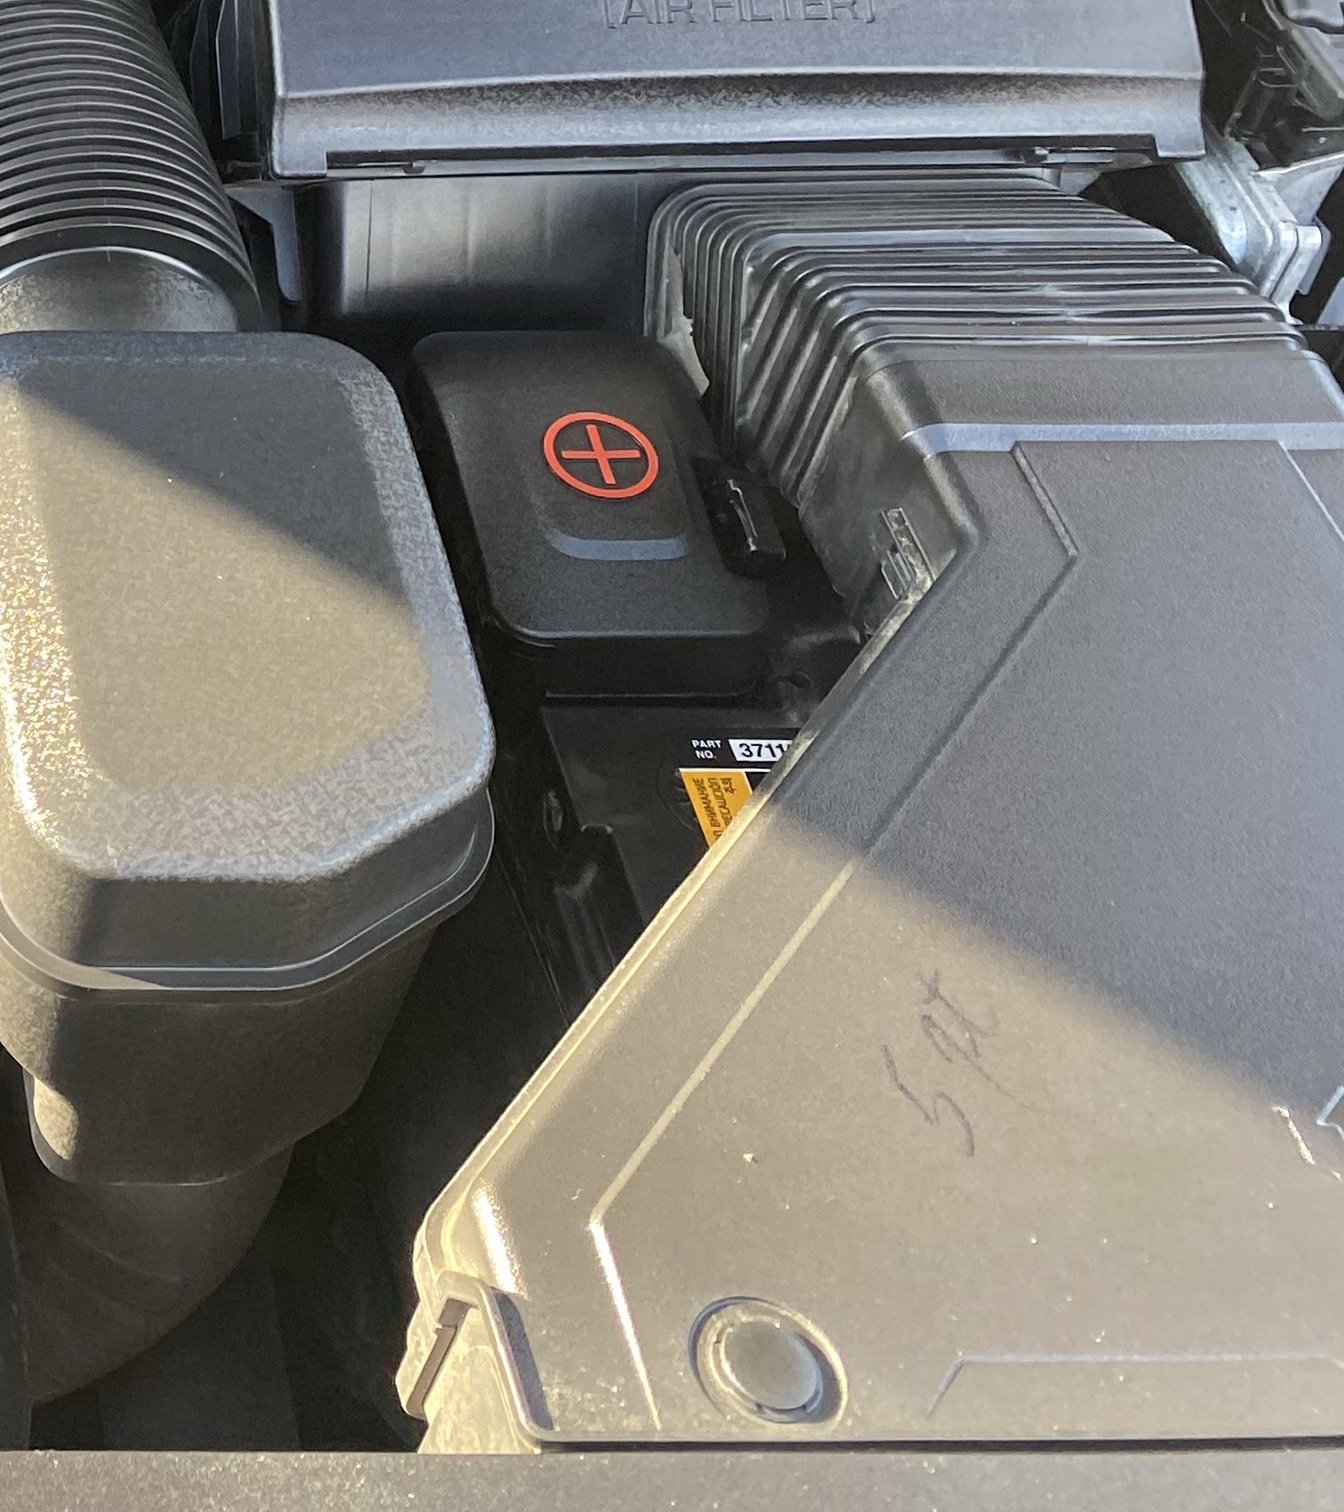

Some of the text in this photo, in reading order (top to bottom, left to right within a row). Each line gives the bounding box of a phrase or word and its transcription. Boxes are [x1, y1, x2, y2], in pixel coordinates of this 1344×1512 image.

[691, 739, 790, 759] PART 3711
[695, 750, 717, 760] NO.
